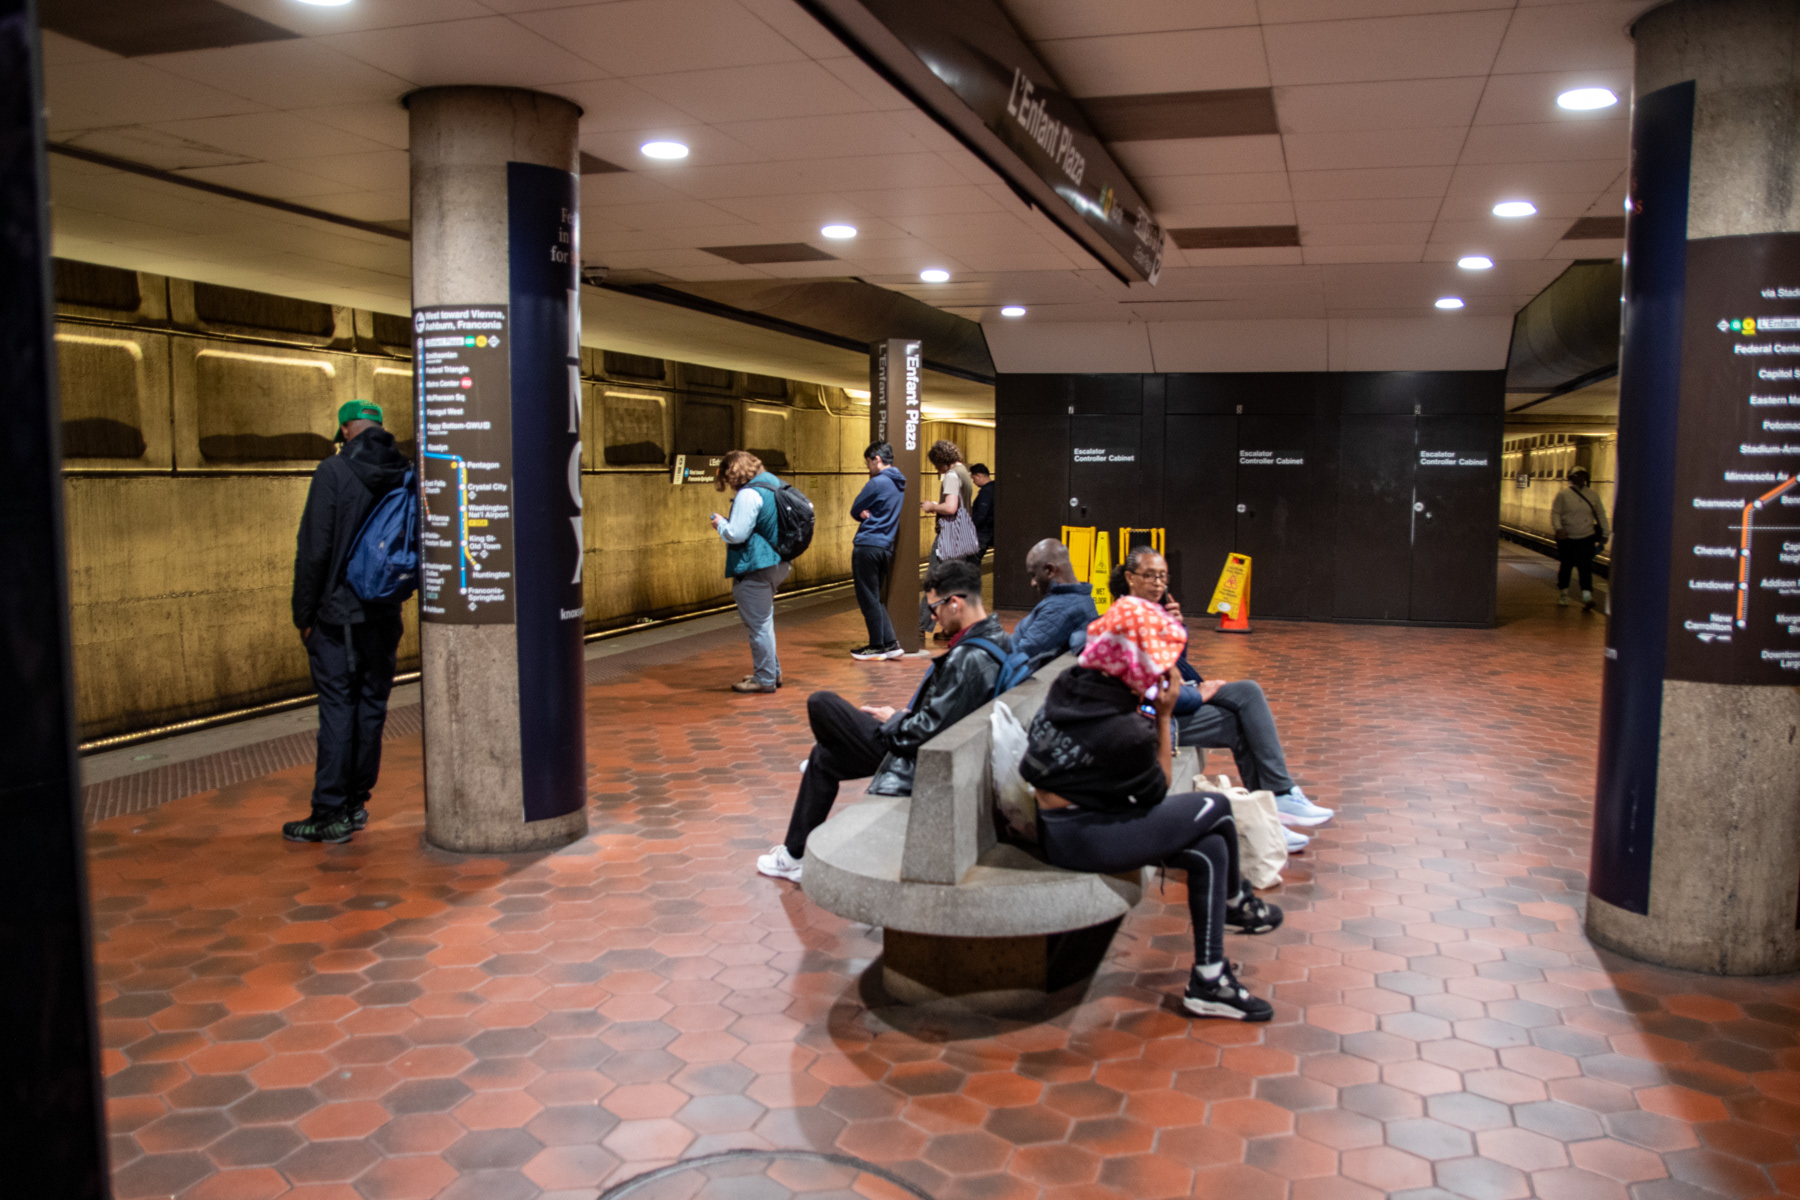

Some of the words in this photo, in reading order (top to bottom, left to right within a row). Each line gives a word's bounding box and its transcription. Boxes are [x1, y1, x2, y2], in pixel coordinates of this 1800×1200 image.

[1007, 66, 1060, 159] L'Enfant
[1055, 124, 1086, 187] Plaza
[441, 310, 469, 320] toward
[470, 309, 505, 320] Vienna,
[457, 320, 502, 330] Franconia
[1733, 344, 1772, 355] Federal
[444, 366, 469, 374] Triangle
[1758, 368, 1792, 380] Capitol
[906, 344, 920, 406] L'Enfant
[455, 394, 466, 402] Sq
[906, 409, 920, 451] Plaza
[467, 461, 500, 470] Pentagon
[1724, 472, 1775, 481] Minnesota
[468, 483, 492, 491] Crystal
[493, 483, 507, 491] City
[1693, 498, 1745, 508] Deanwood
[468, 505, 508, 513] Washington
[469, 535, 485, 543] King
[1693, 546, 1736, 558] Cheverly
[472, 571, 510, 579] Huntington
[1689, 581, 1735, 591] Landover
[468, 594, 504, 602] Springfield
[1710, 614, 1733, 623] New
